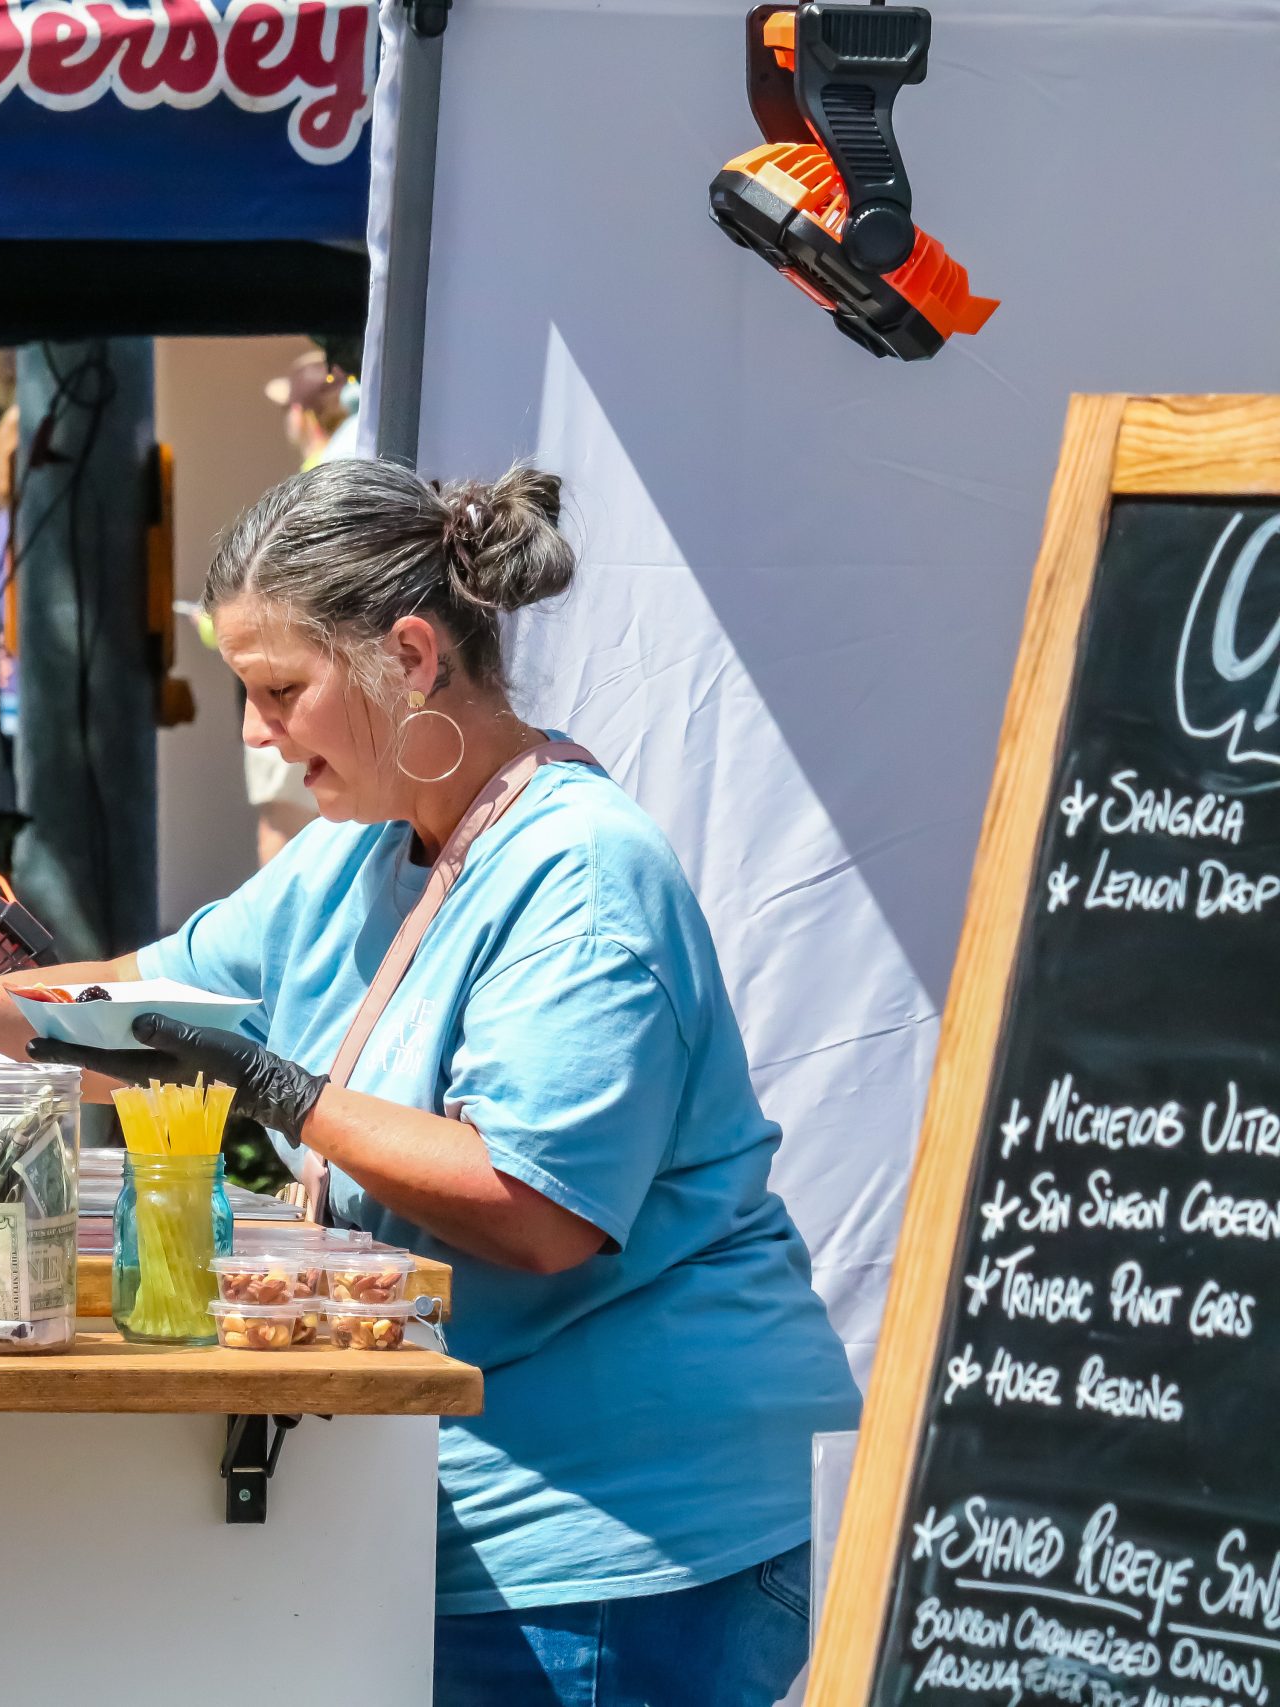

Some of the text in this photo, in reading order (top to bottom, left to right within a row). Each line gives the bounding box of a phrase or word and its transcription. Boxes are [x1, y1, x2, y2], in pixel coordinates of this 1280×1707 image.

[1084, 848, 1280, 919] LEMON DROP
[940, 1495, 1065, 1578] SHAVED
